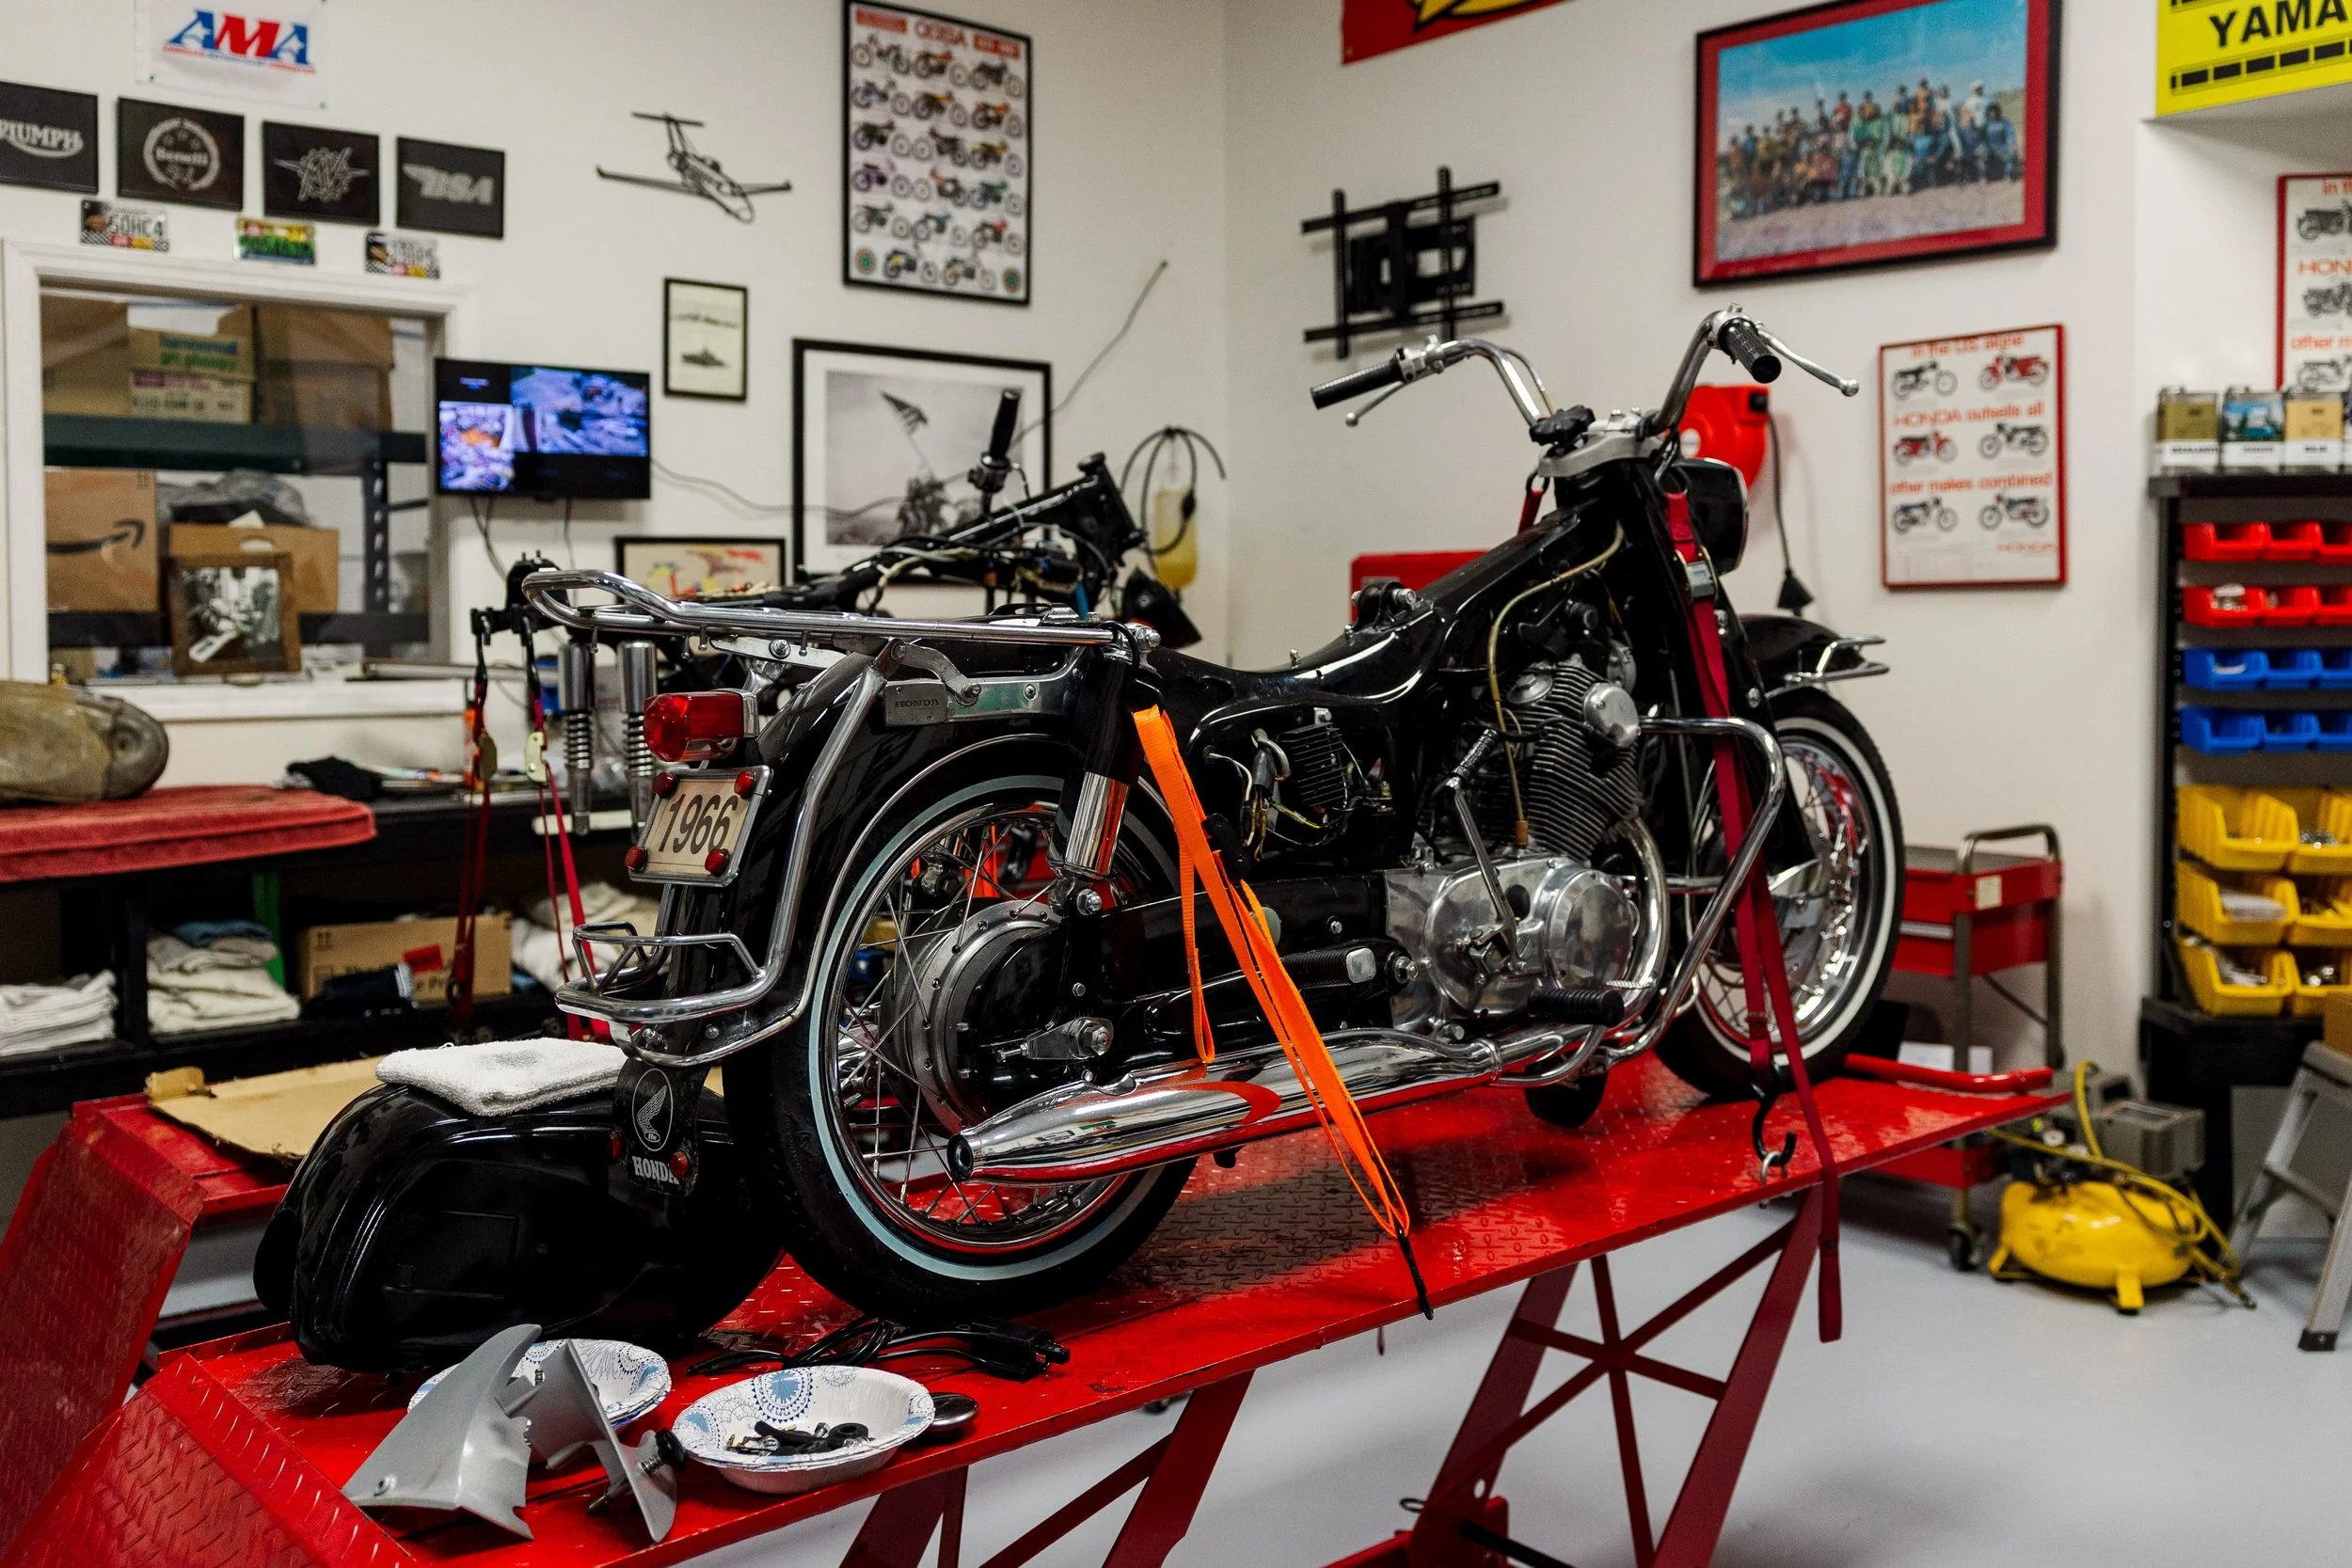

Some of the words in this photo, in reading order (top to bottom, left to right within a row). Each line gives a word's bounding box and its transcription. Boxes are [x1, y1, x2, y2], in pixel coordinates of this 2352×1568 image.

[2209, 0, 2348, 48] YAMA
[167, 9, 308, 65] AMA
[1929, 342, 1950, 357] the
[1894, 408, 1961, 426] HONDA
[2027, 401, 2044, 417] all
[1892, 481, 1922, 495] other
[1930, 476, 1973, 492] makes
[1979, 472, 2053, 489] combined
[895, 699, 941, 708] HONDA
[659, 793, 739, 855] 1966
